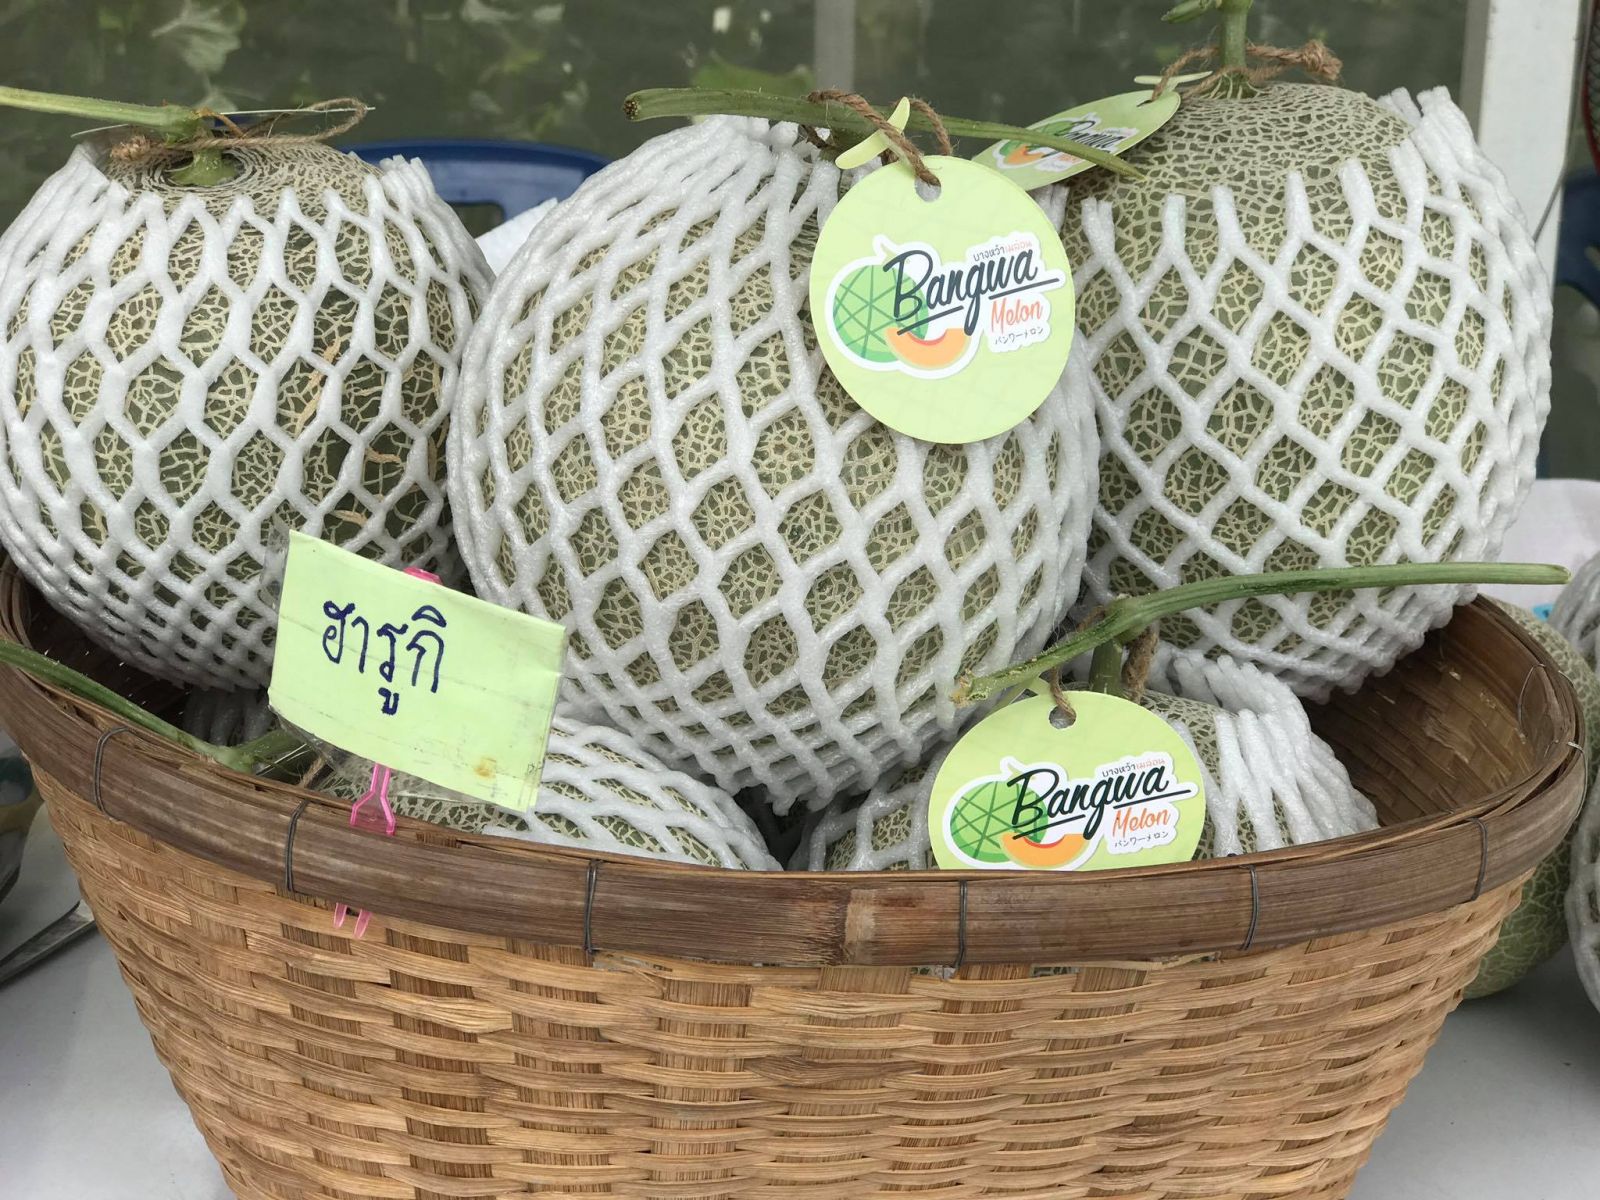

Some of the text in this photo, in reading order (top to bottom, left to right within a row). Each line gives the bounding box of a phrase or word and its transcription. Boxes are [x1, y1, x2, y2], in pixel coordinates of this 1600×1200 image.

[882, 249, 1039, 336] Bangwa
[990, 298, 1044, 334] Melon
[321, 600, 448, 716] ฮารูกิ
[1006, 765, 1170, 841] Bangwa
[1111, 807, 1172, 838] Melon
